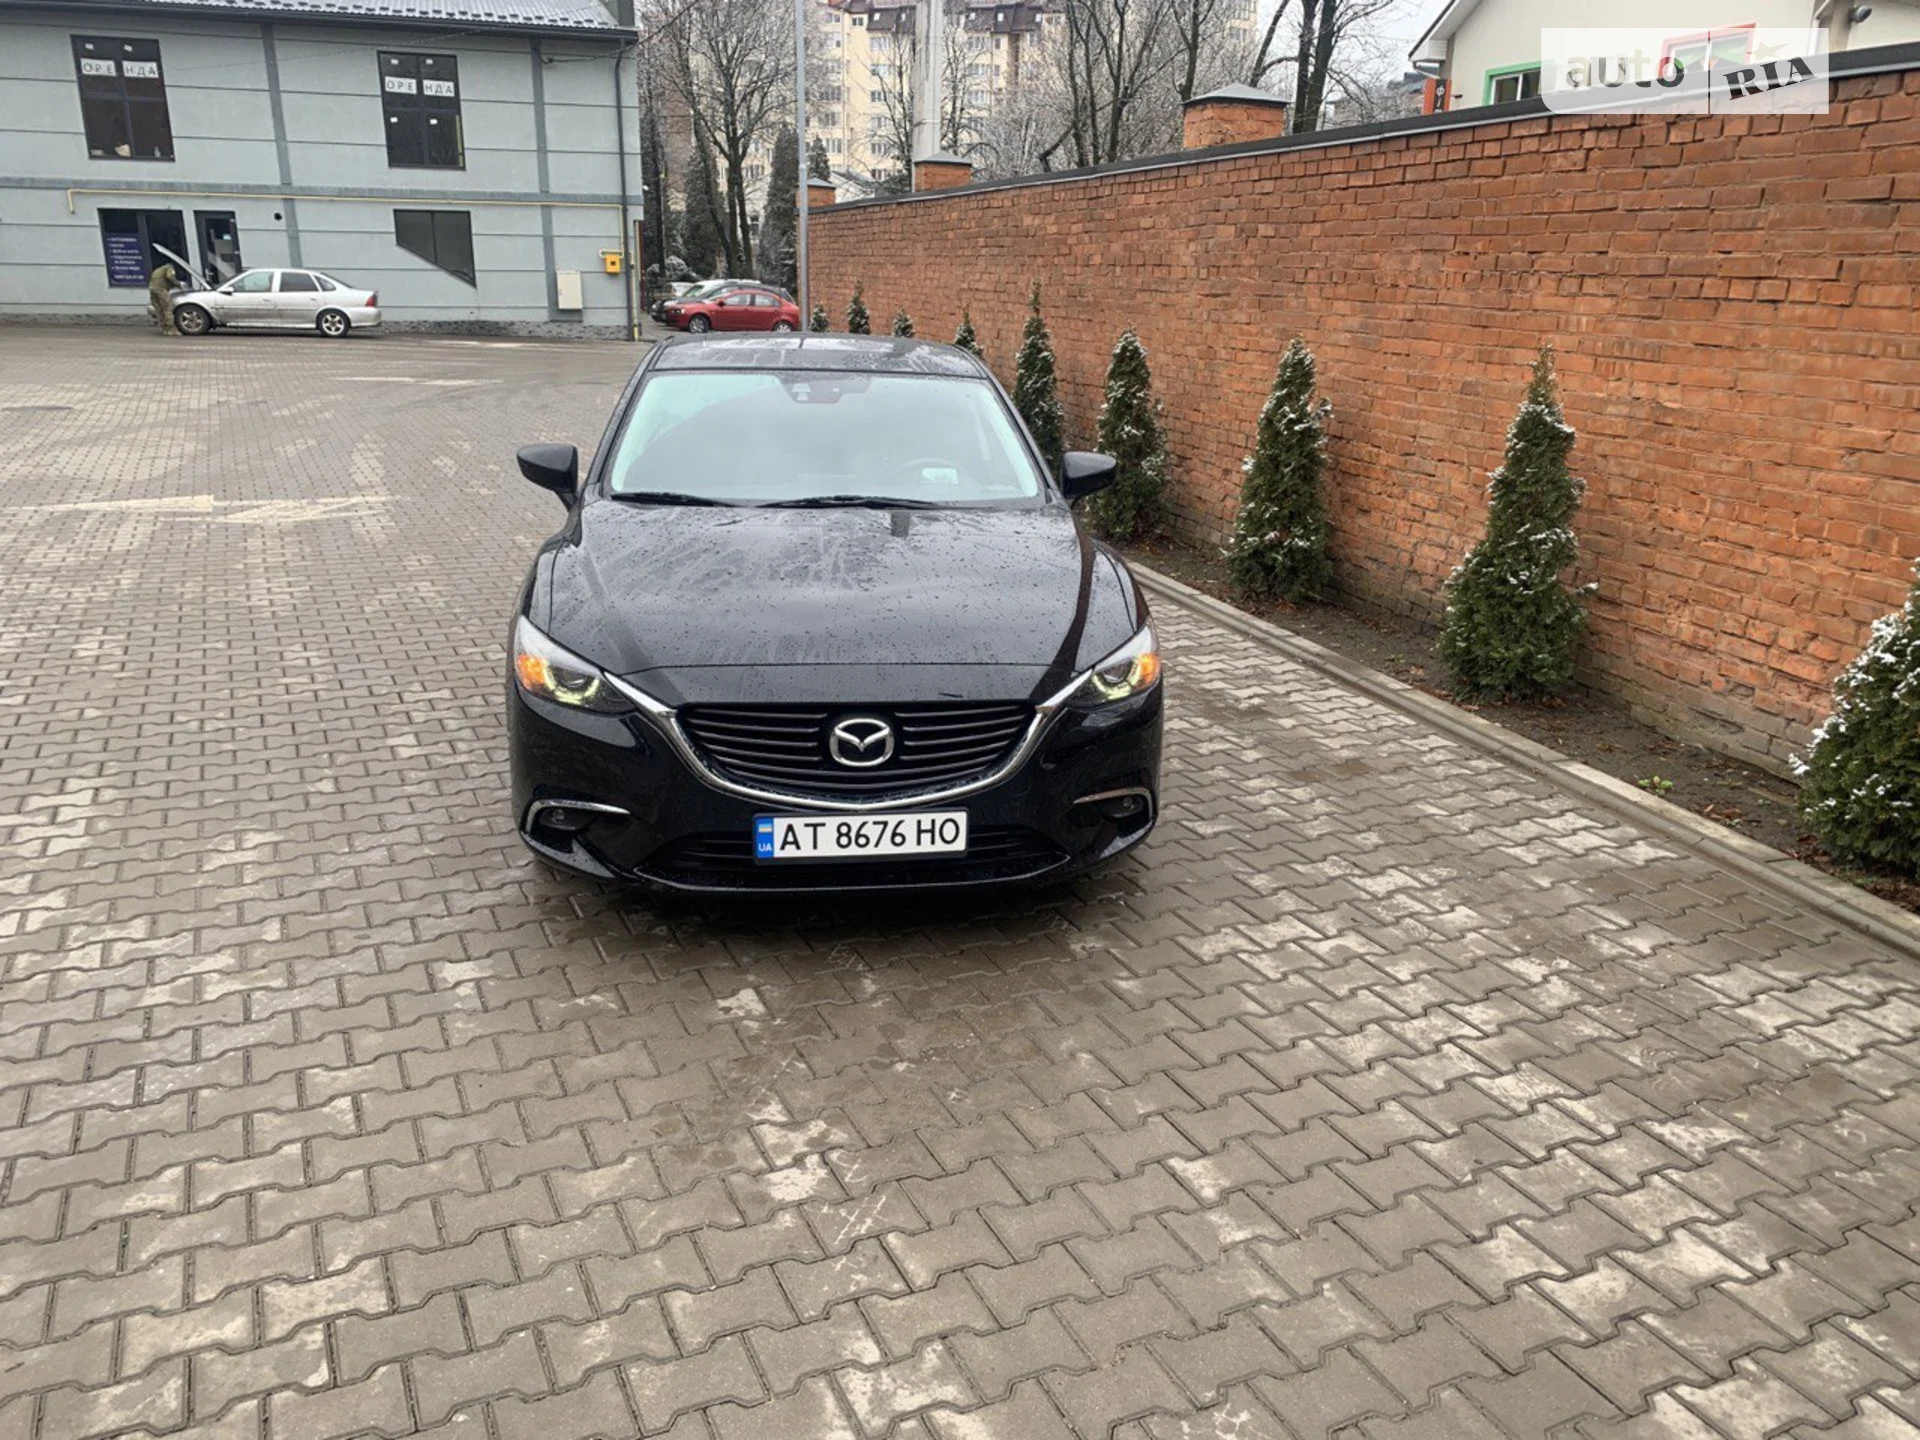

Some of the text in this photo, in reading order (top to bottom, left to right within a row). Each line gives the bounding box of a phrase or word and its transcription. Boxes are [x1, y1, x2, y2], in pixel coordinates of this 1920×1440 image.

[780, 818, 960, 850] AT 8676 HO
[758, 843, 772, 852] UA
